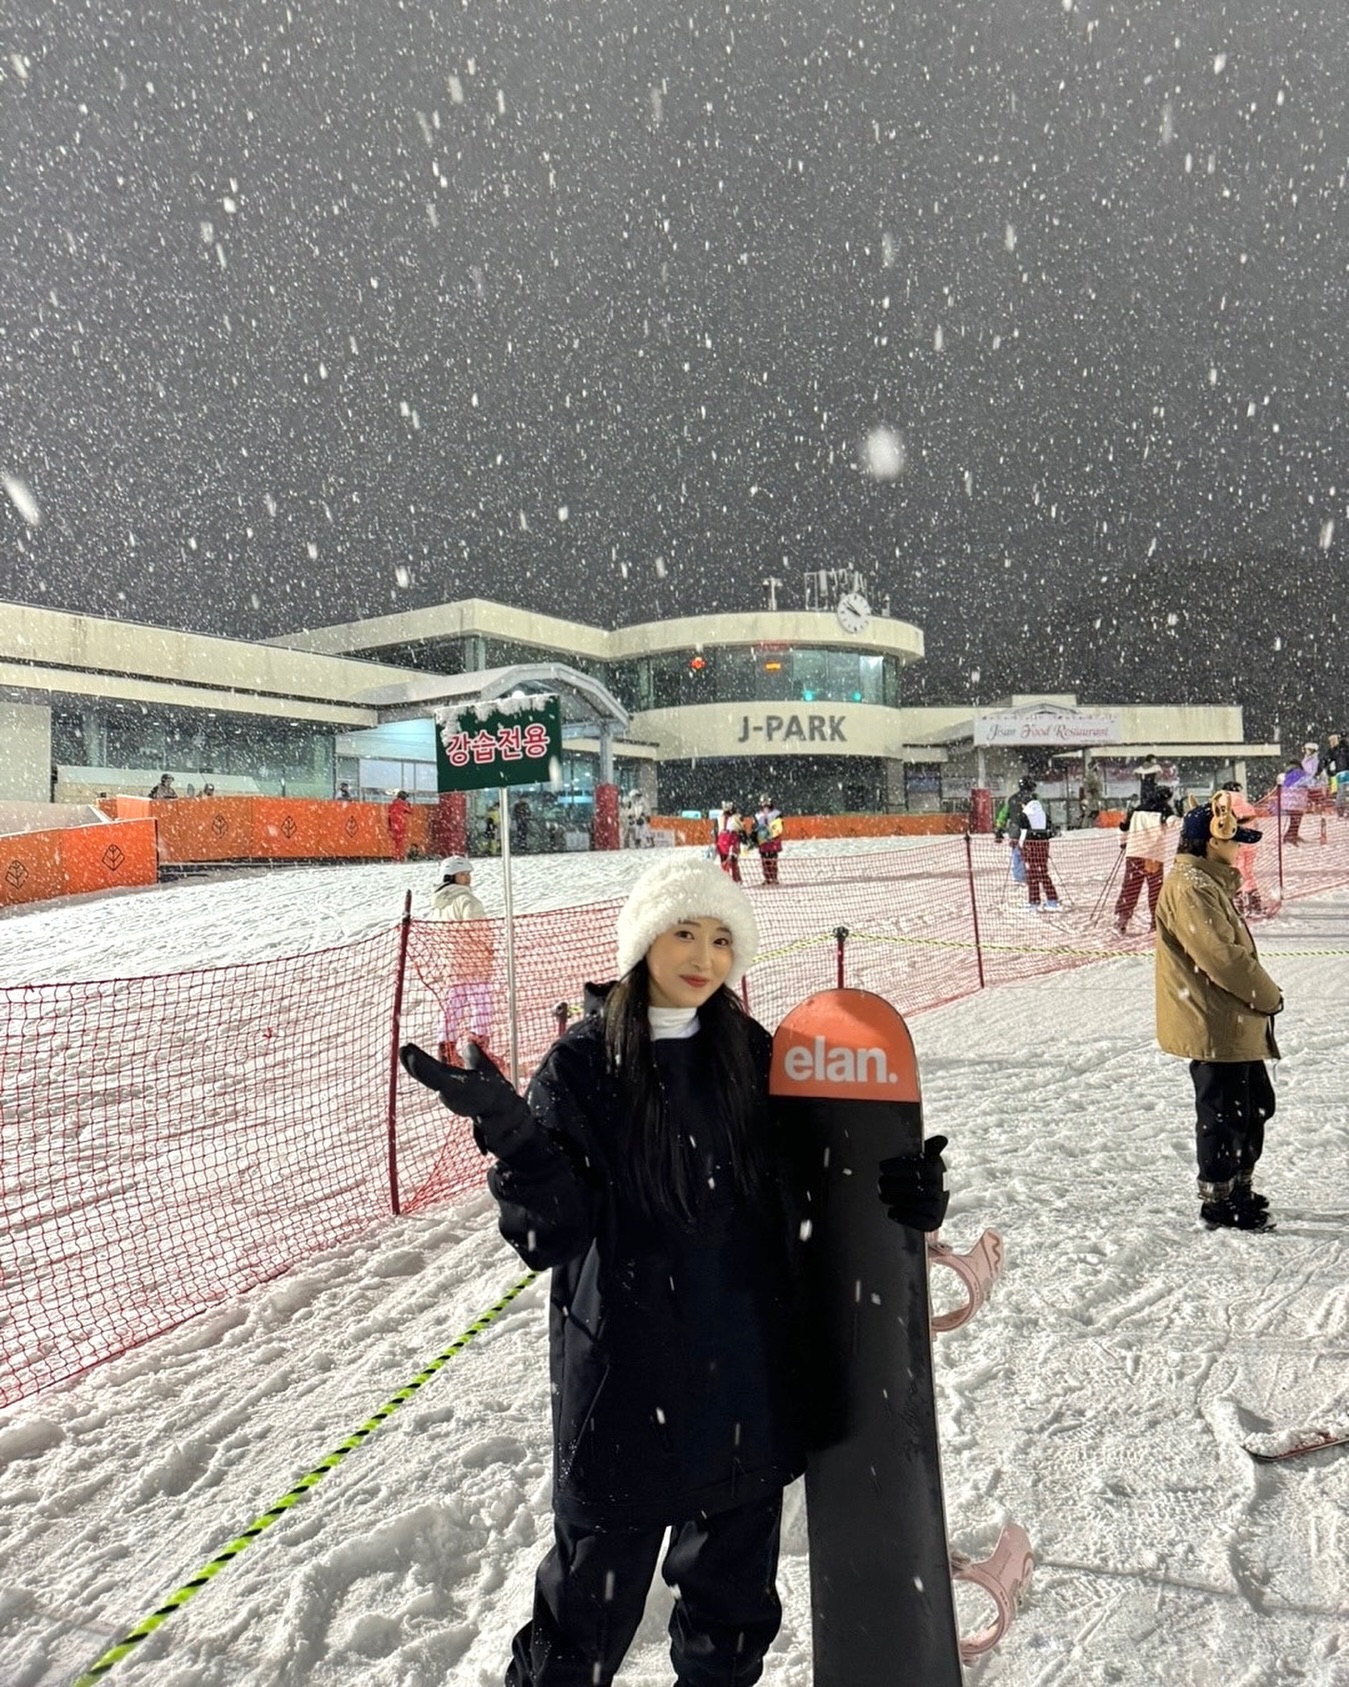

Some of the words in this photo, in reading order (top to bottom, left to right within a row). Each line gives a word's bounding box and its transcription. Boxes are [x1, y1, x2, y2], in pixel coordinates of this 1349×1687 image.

[446, 724, 550, 766] 강습전용
[738, 715, 848, 743] J-PARK
[1020, 723, 1050, 738] Food
[1053, 723, 1109, 740] Restaurant
[784, 1035, 898, 1083] elan.
